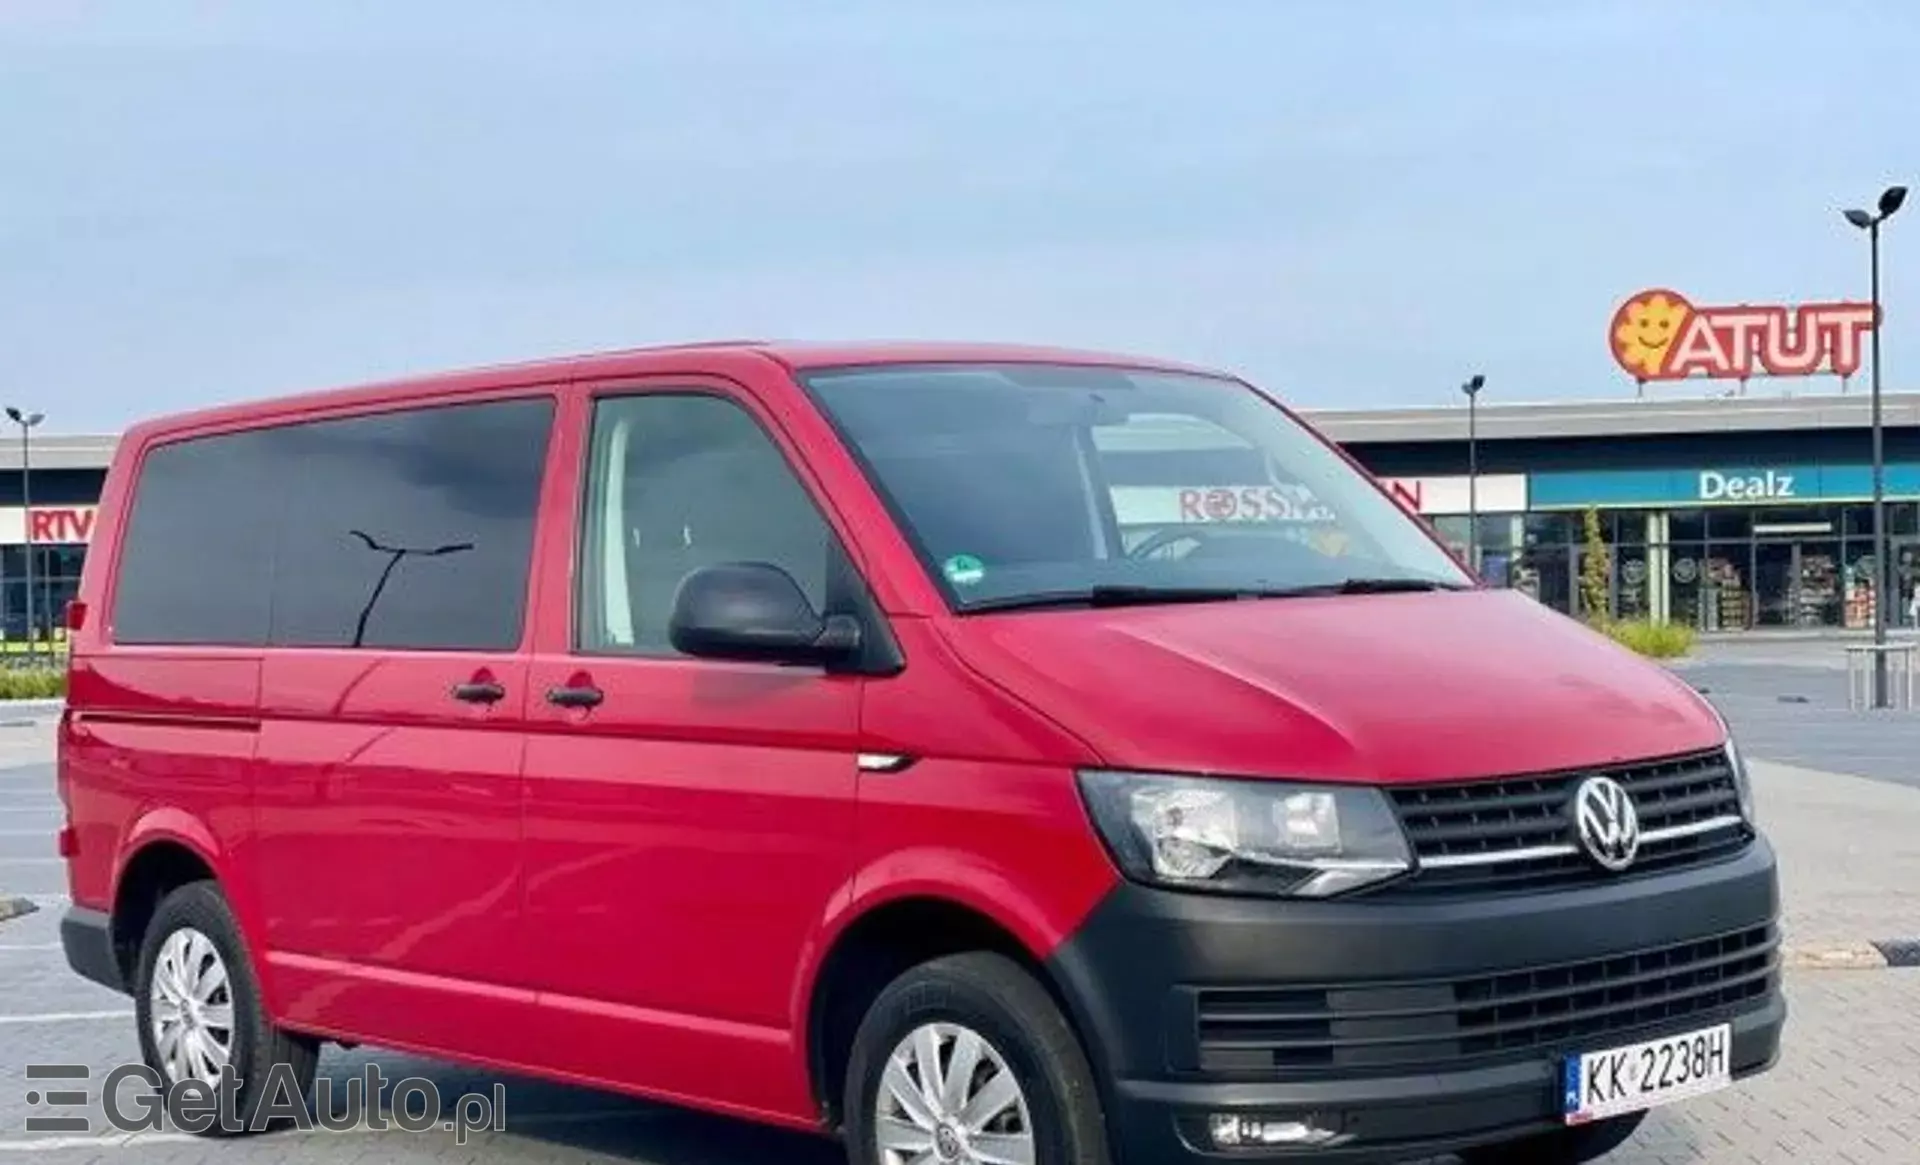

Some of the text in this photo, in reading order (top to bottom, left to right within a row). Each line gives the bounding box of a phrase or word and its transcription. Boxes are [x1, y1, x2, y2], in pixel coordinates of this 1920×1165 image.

[1667, 306, 1880, 374] ATUT
[1700, 469, 1795, 499] Dealz
[32, 510, 93, 541] RTV
[1587, 1030, 1724, 1104] KK 2238H
